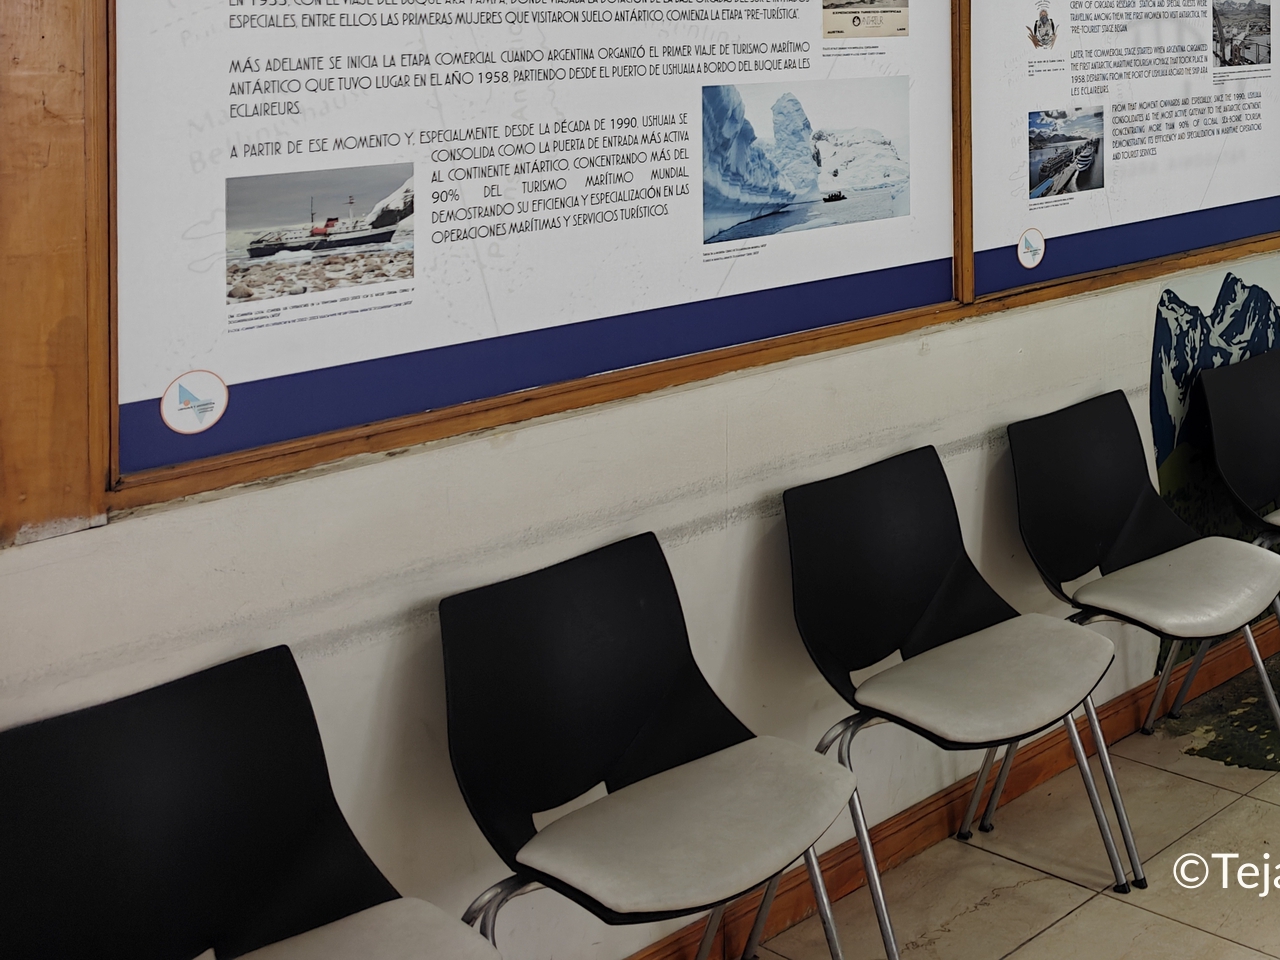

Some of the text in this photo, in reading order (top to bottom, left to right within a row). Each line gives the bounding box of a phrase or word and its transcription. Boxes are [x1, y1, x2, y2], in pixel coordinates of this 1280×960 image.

[301, 13, 336, 27] ENTRE
[339, 12, 377, 26] ELLOS
[380, 12, 399, 26] LAS
[402, 12, 453, 25] PRIMERAS
[454, 11, 503, 24] MUJERES
[504, 10, 530, 24] QUE
[530, 10, 579, 23] VISITARON
[581, 10, 613, 22] SUELO
[665, 9, 709, 21] COMIENZA
[710, 9, 720, 20] LA
[721, 8, 743, 20] ETAPA
[229, 145, 238, 158] A
[243, 141, 282, 156] PARTIR
[287, 139, 303, 154] DE
[308, 137, 328, 152] ESE
[332, 132, 401, 149] MOMENTO
[504, 123, 535, 137] DESDE
[538, 122, 550, 135] LA
[553, 119, 591, 133] DÉCADA
[594, 118, 606, 130] DE
[642, 114, 676, 127] USHUAIA
[678, 112, 688, 124] SE
[430, 130, 689, 162] CONSOLIDA COMO LA PUERTA DE ENTRADA MÁS ACTIVA
[431, 188, 460, 203] 90%
[483, 184, 502, 197] DEL
[521, 177, 567, 193] TURISMO
[584, 170, 634, 186] MARÍTIMO
[431, 222, 507, 243] OPERACIONES
[508, 216, 561, 234] MARÍTIMAS
[562, 214, 571, 227] Y
[572, 209, 618, 226] SERVICIOS
